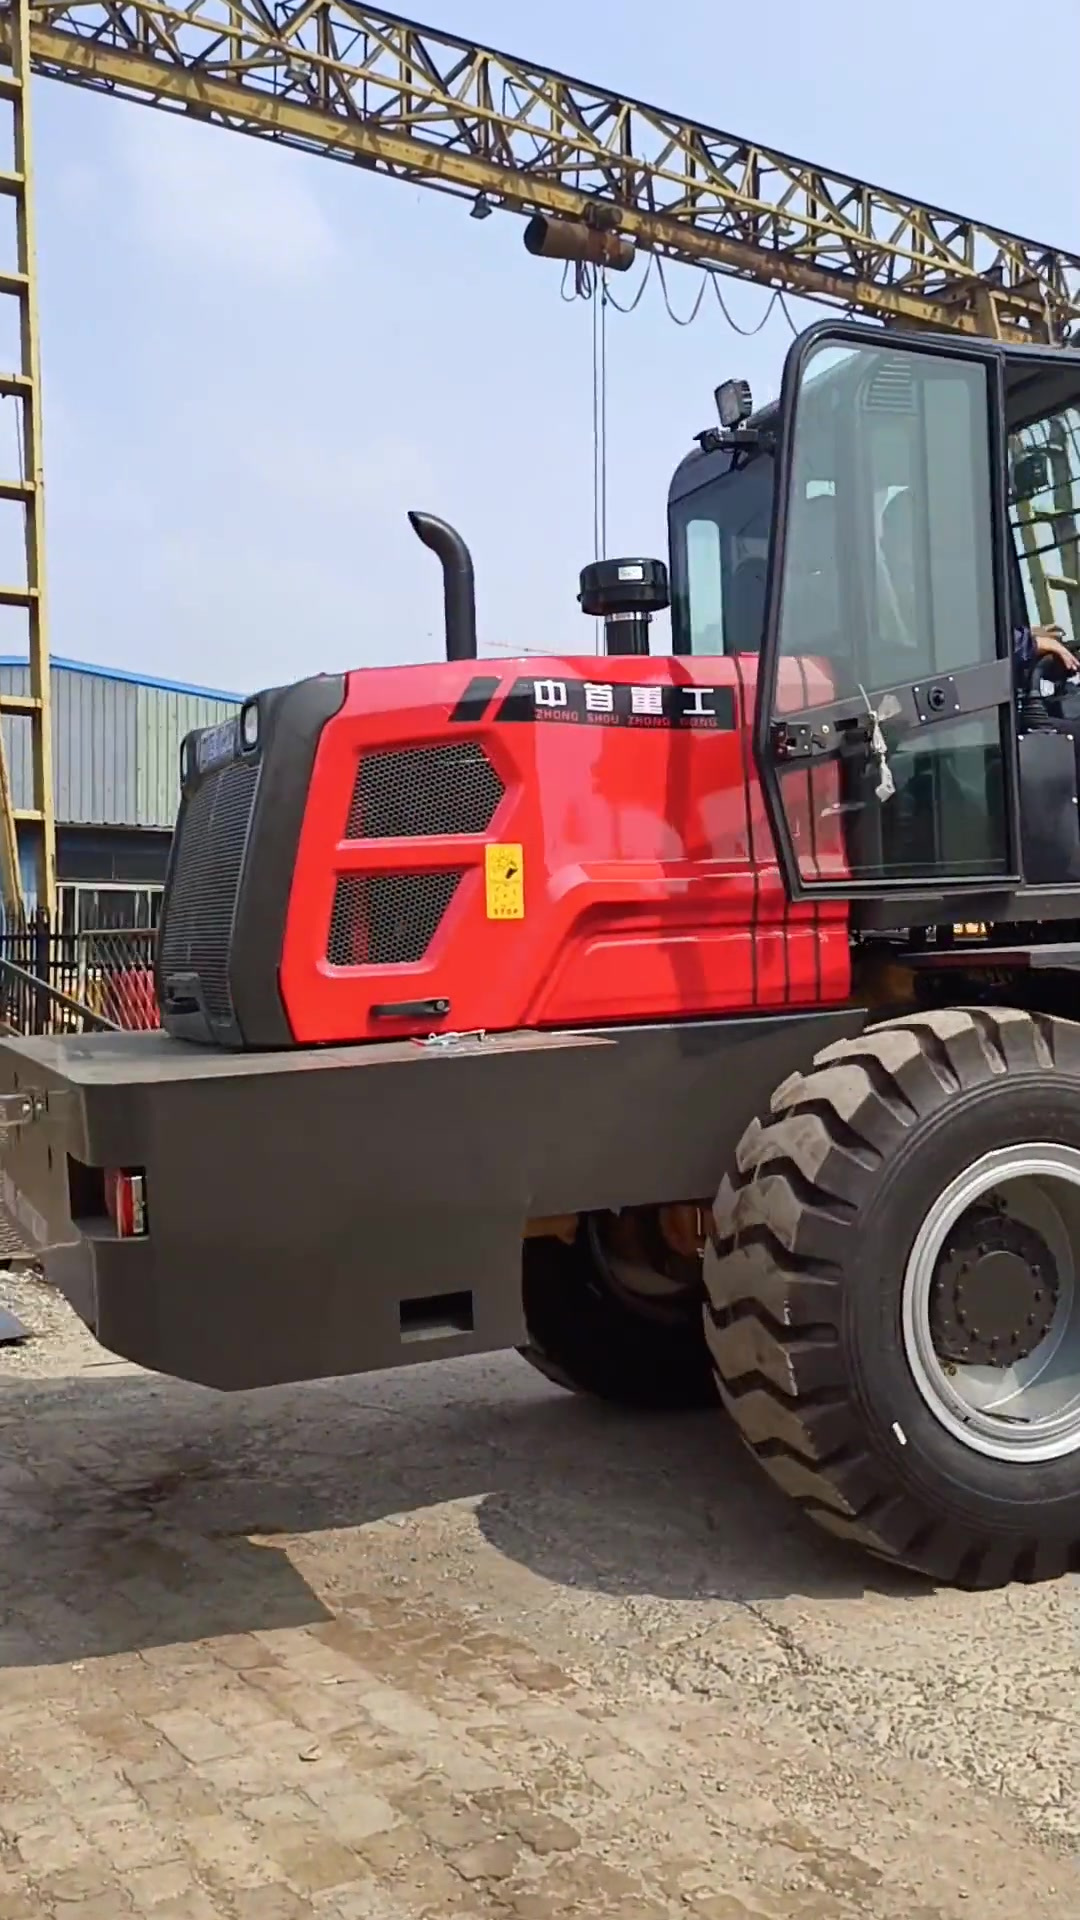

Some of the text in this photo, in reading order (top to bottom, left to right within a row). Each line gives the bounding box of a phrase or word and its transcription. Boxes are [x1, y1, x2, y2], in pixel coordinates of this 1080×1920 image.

[534, 680, 716, 715] 中首重工
[535, 708, 578, 722] ZHONG
[586, 711, 619, 724] SHOU
